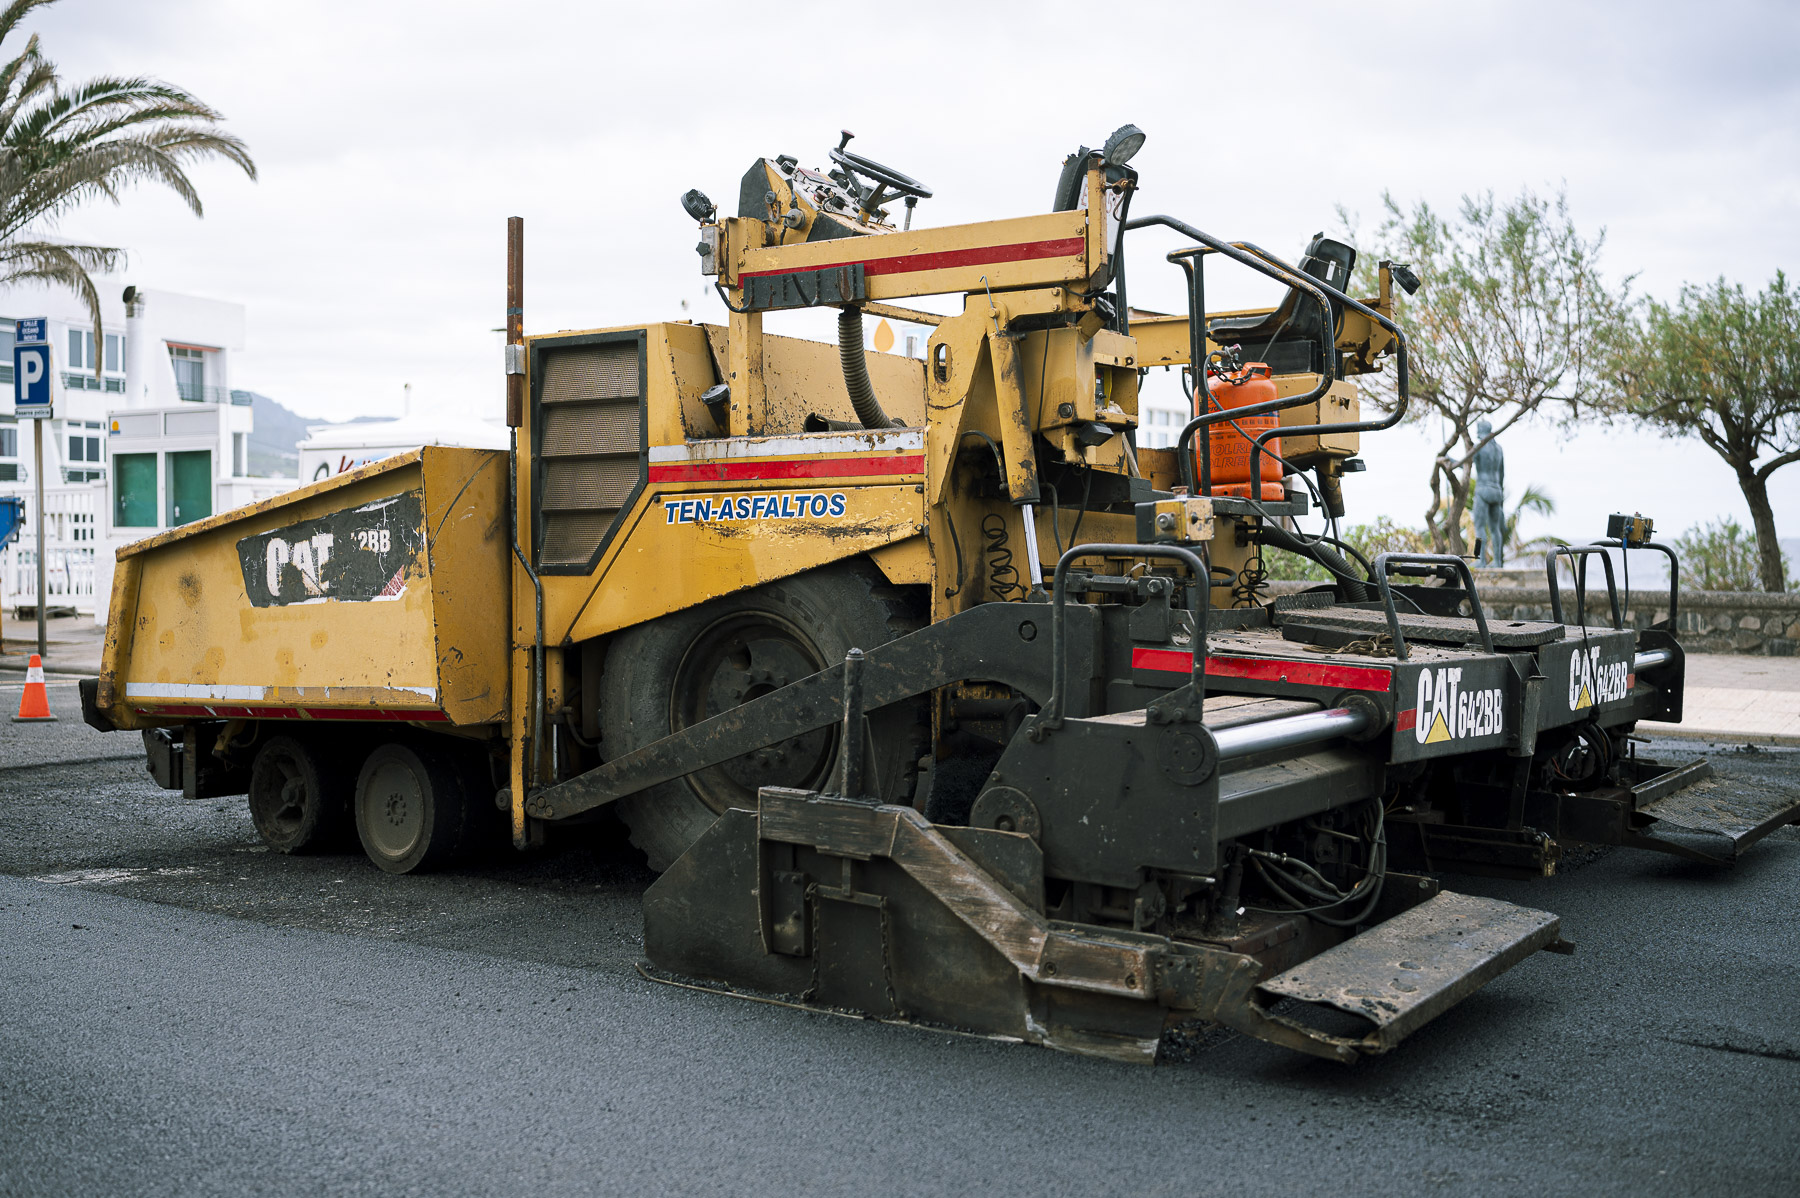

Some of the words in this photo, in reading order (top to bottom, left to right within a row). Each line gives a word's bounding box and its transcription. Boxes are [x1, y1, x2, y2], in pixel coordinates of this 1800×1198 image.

[20, 350, 44, 400] P
[664, 492, 847, 525] TEN-ASFALTOS
[266, 535, 334, 597] CAT
[1415, 667, 1463, 744] CAT
[1458, 688, 1503, 739] 642BB
[1569, 646, 1601, 711] CAT
[1597, 661, 1628, 704] 642BB
